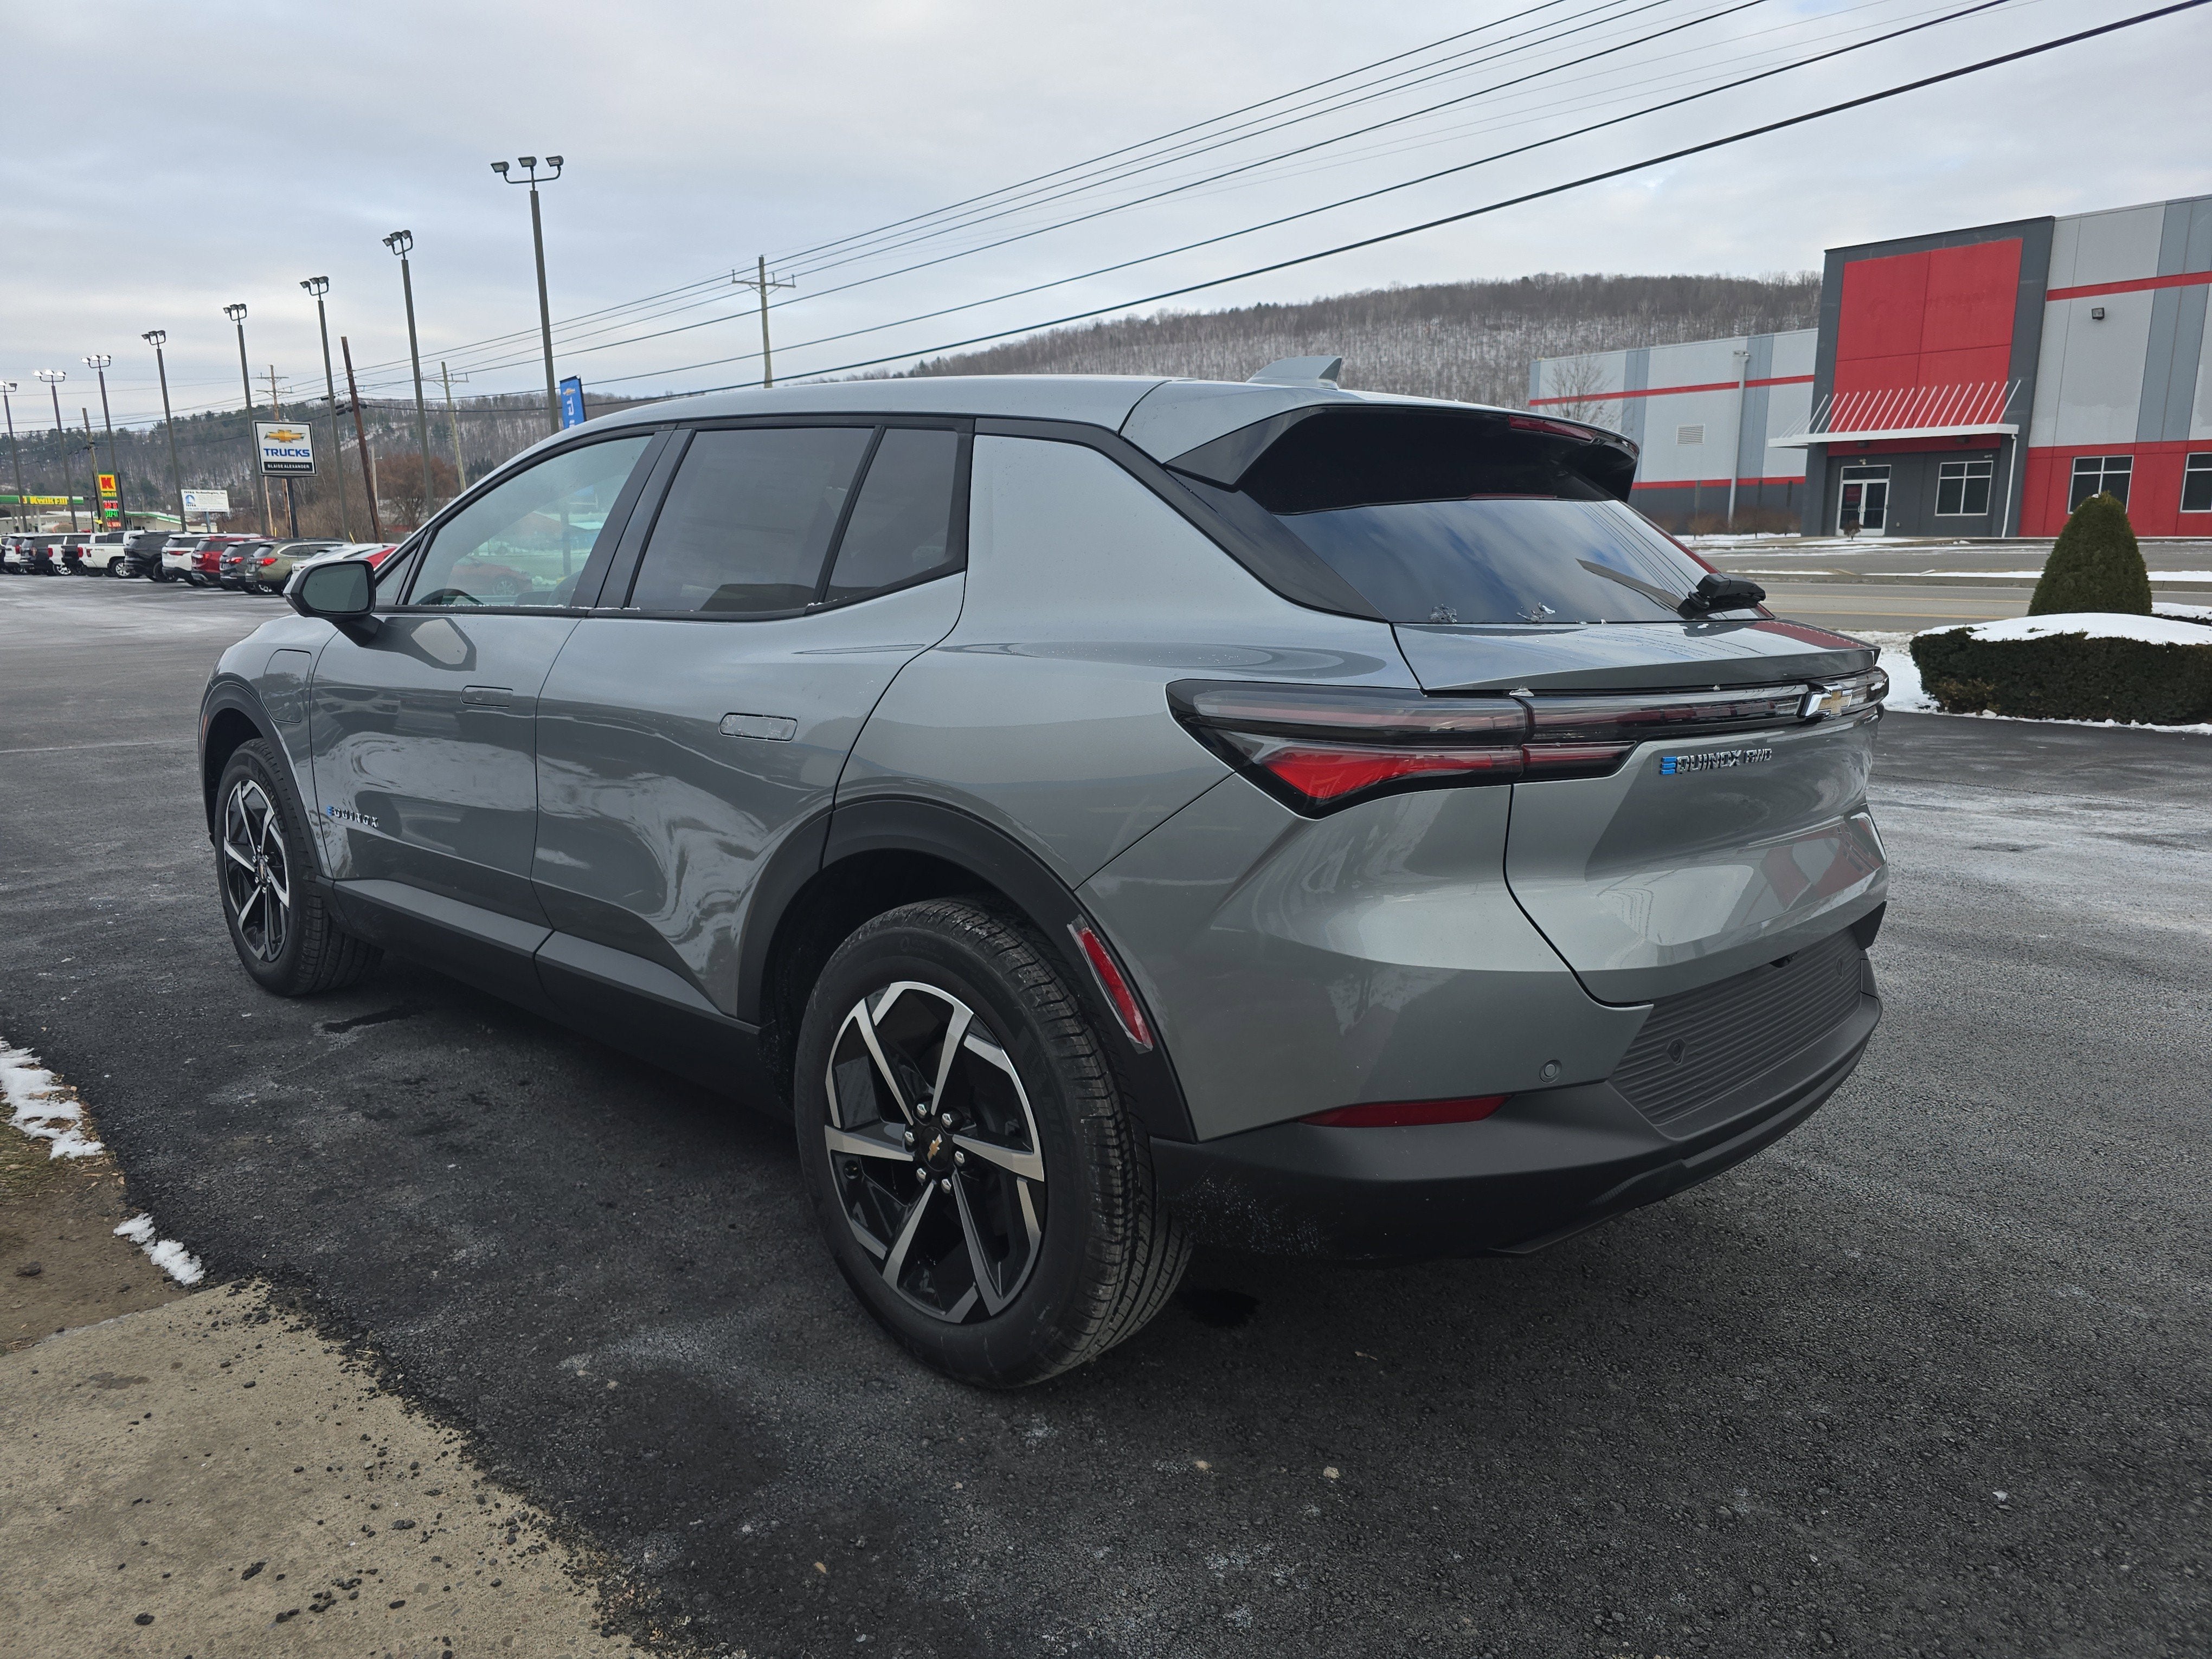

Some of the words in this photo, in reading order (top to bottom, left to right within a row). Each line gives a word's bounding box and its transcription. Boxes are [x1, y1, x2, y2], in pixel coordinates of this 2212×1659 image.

[263, 448, 310, 457] TRUCKS
[101, 478, 114, 489] K
[1660, 750, 1741, 775] EQUINOX
[327, 806, 379, 828] EQUINOX
